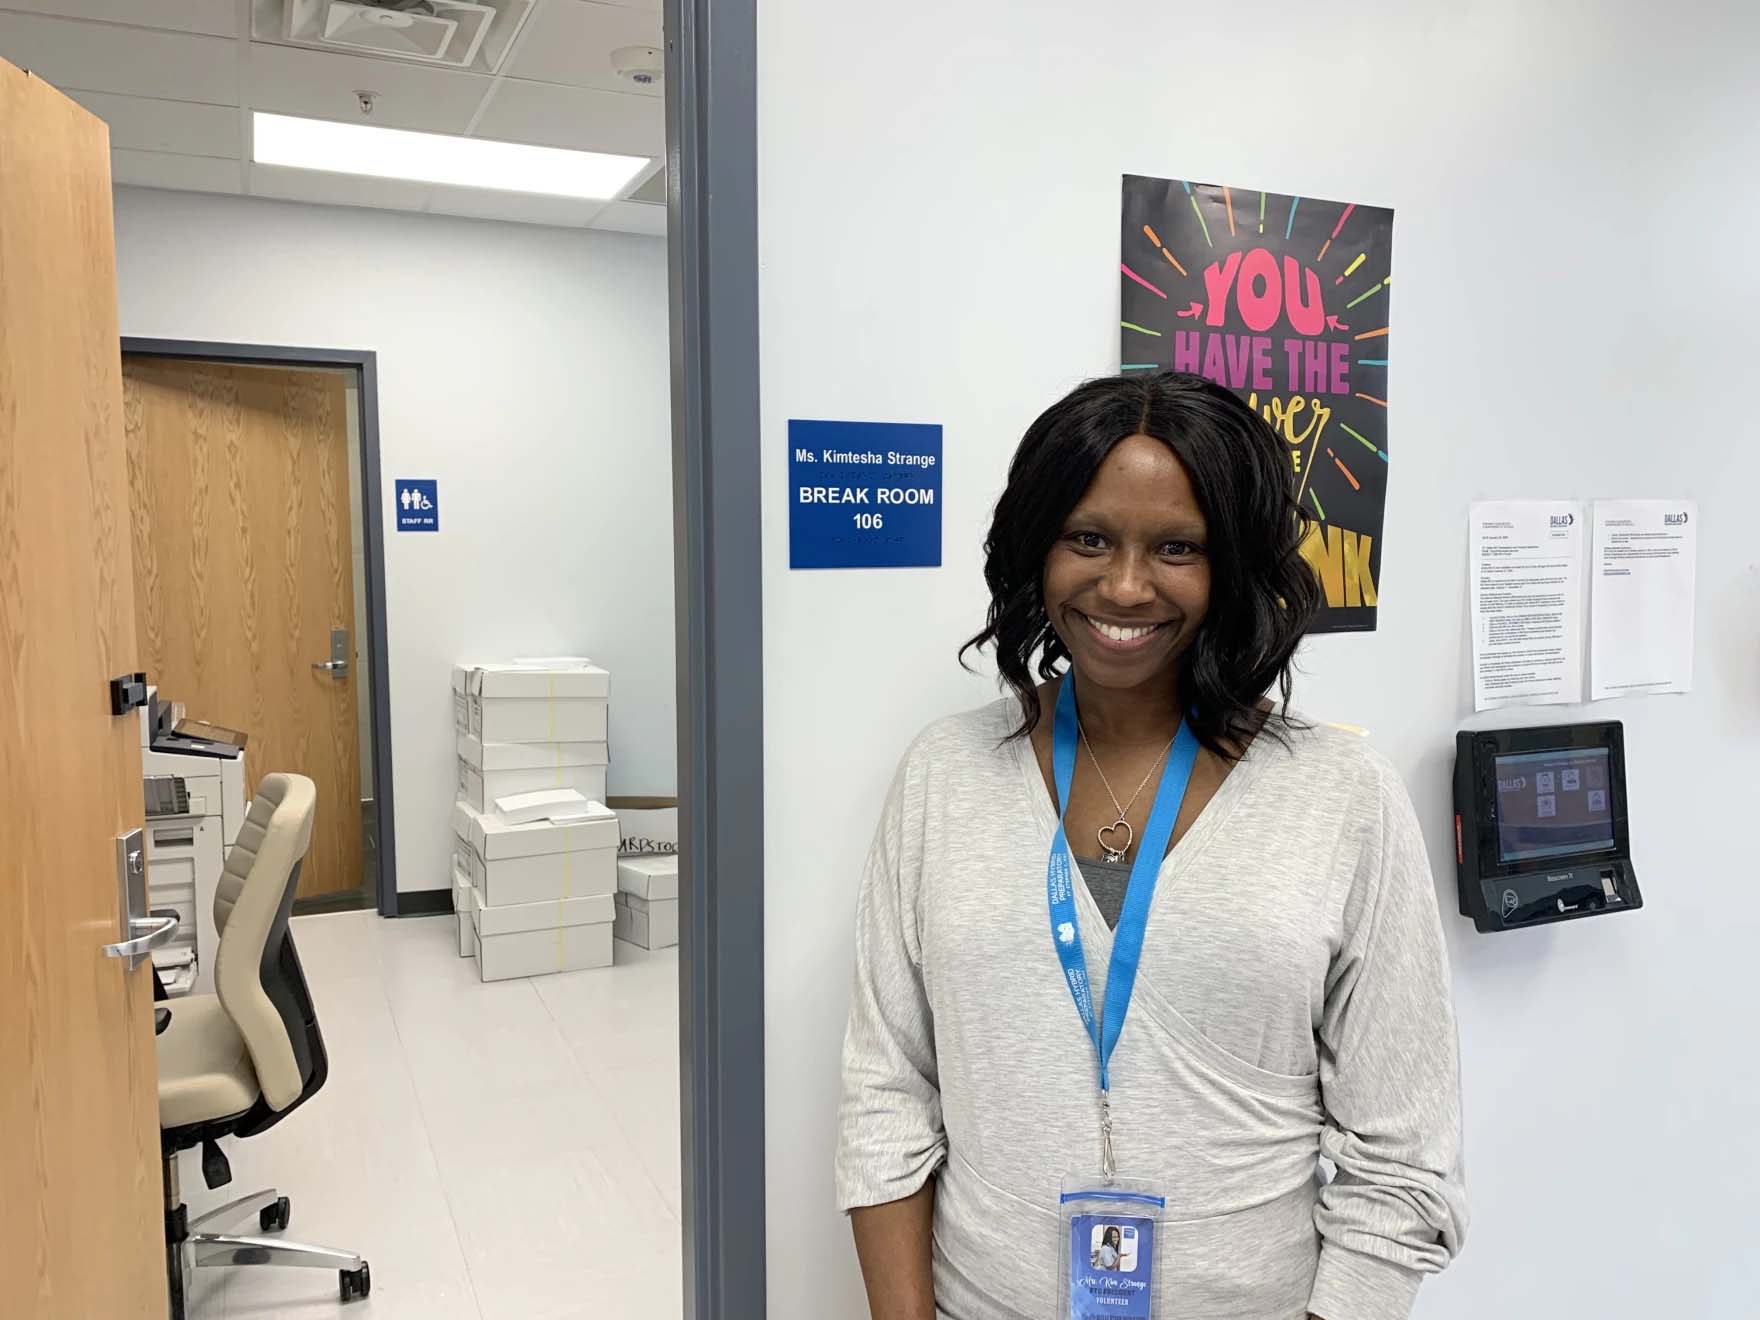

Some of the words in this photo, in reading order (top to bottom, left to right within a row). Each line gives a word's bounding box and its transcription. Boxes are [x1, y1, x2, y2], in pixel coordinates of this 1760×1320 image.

[1204, 248, 1325, 335] YOU
[1174, 331, 1273, 390] HAVE
[1284, 339, 1350, 394] THE
[796, 449, 818, 463] Ms.
[823, 450, 882, 465] Kimtesha
[887, 451, 936, 468] Strange
[800, 487, 869, 504] BREAK
[877, 488, 934, 504] ROOM
[853, 513, 883, 529] 106
[1550, 515, 1568, 525] DALLAS
[1664, 513, 1683, 523] DALLAS
[618, 837, 679, 853] ARDSTOC
[1057, 853, 1066, 901] PREPARATORY
[1050, 878, 1059, 904] DALLAS
[1067, 968, 1081, 995] HYBRID
[1096, 1297, 1128, 1305] VOLUNTEER
